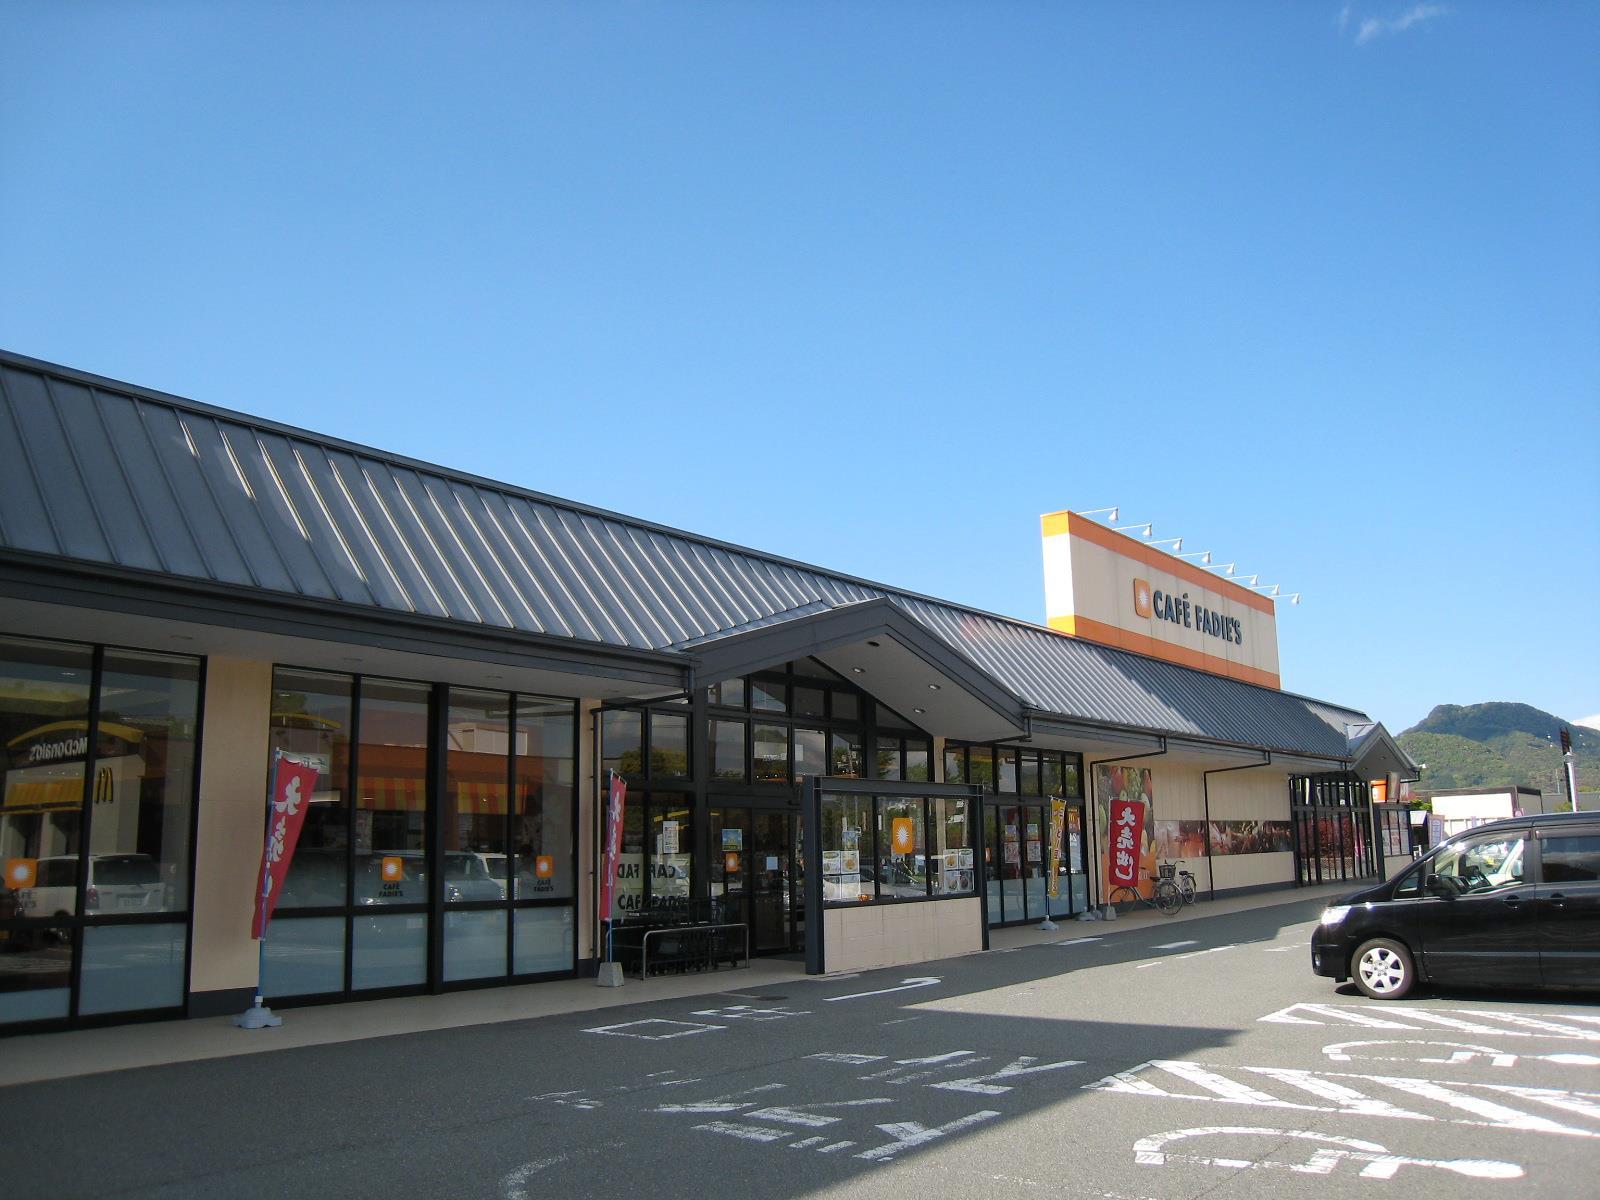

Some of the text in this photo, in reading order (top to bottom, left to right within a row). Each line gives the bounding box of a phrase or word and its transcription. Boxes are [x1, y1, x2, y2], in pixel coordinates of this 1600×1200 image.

[1153, 590, 1243, 646] CAFÉ FADIE'S
[1115, 806, 1136, 881] 大売出し
